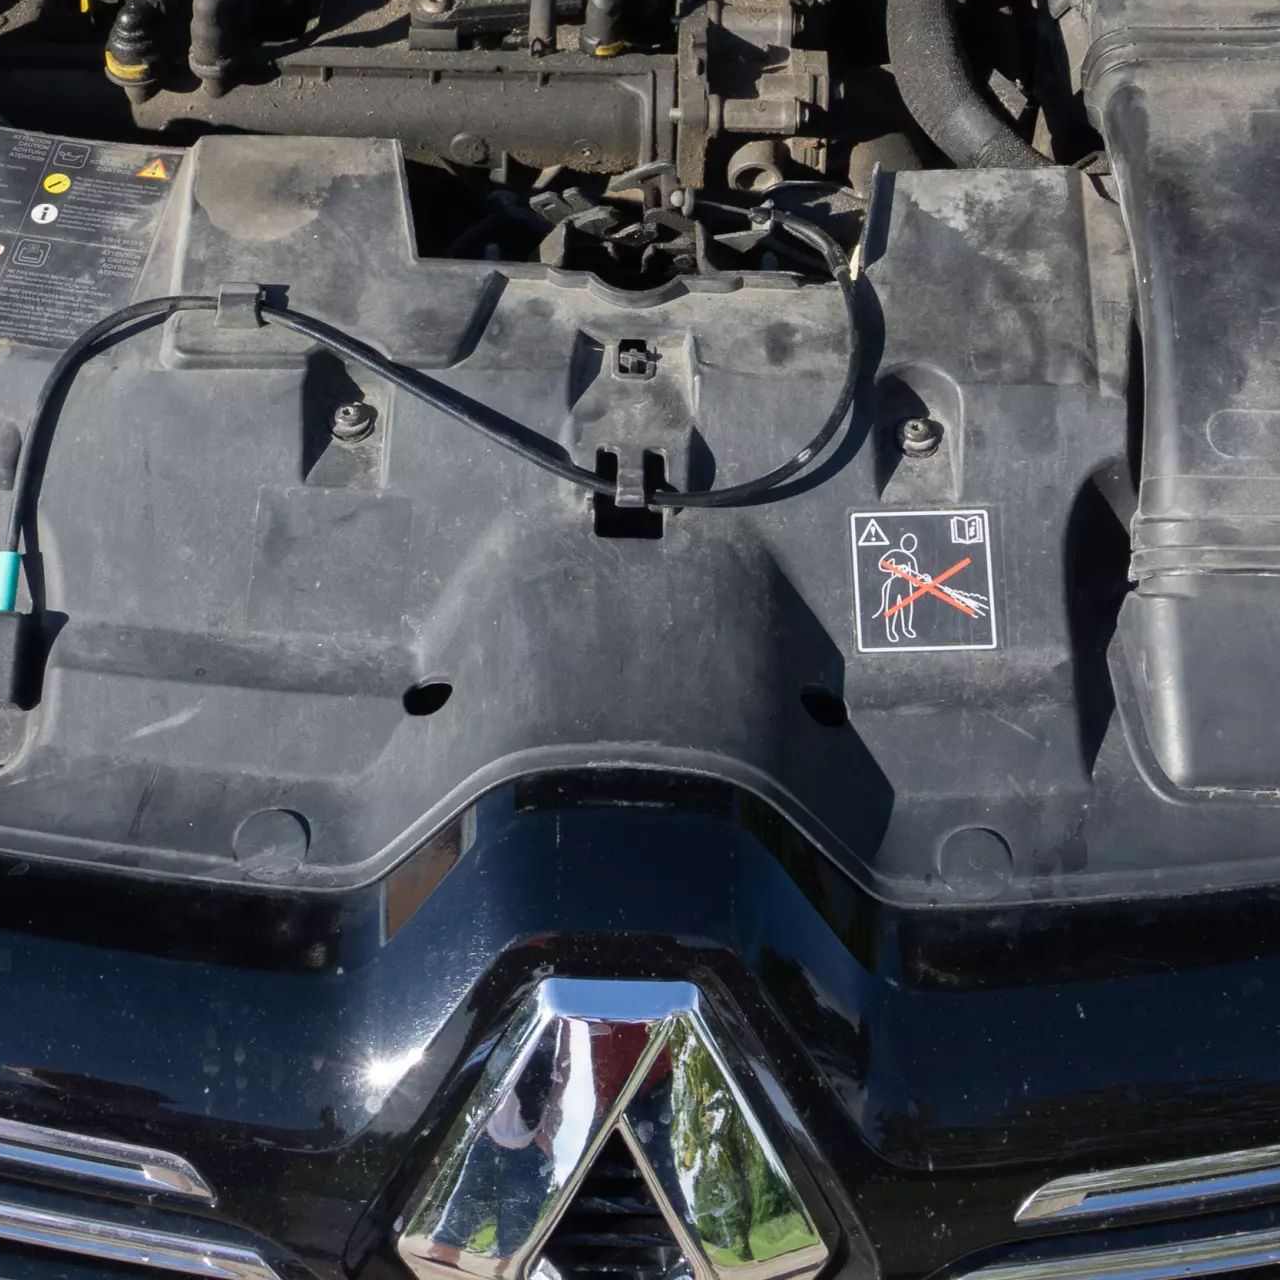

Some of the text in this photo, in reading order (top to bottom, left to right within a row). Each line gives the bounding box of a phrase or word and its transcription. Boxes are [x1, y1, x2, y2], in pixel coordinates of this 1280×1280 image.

[11, 134, 52, 144] ATTENTION
[17, 141, 50, 149] CAUTION
[11, 146, 48, 155] ACHTUNG
[101, 249, 142, 260] ATTENTION
[106, 257, 139, 266] CAUTION
[101, 263, 136, 272] ACHTUNG
